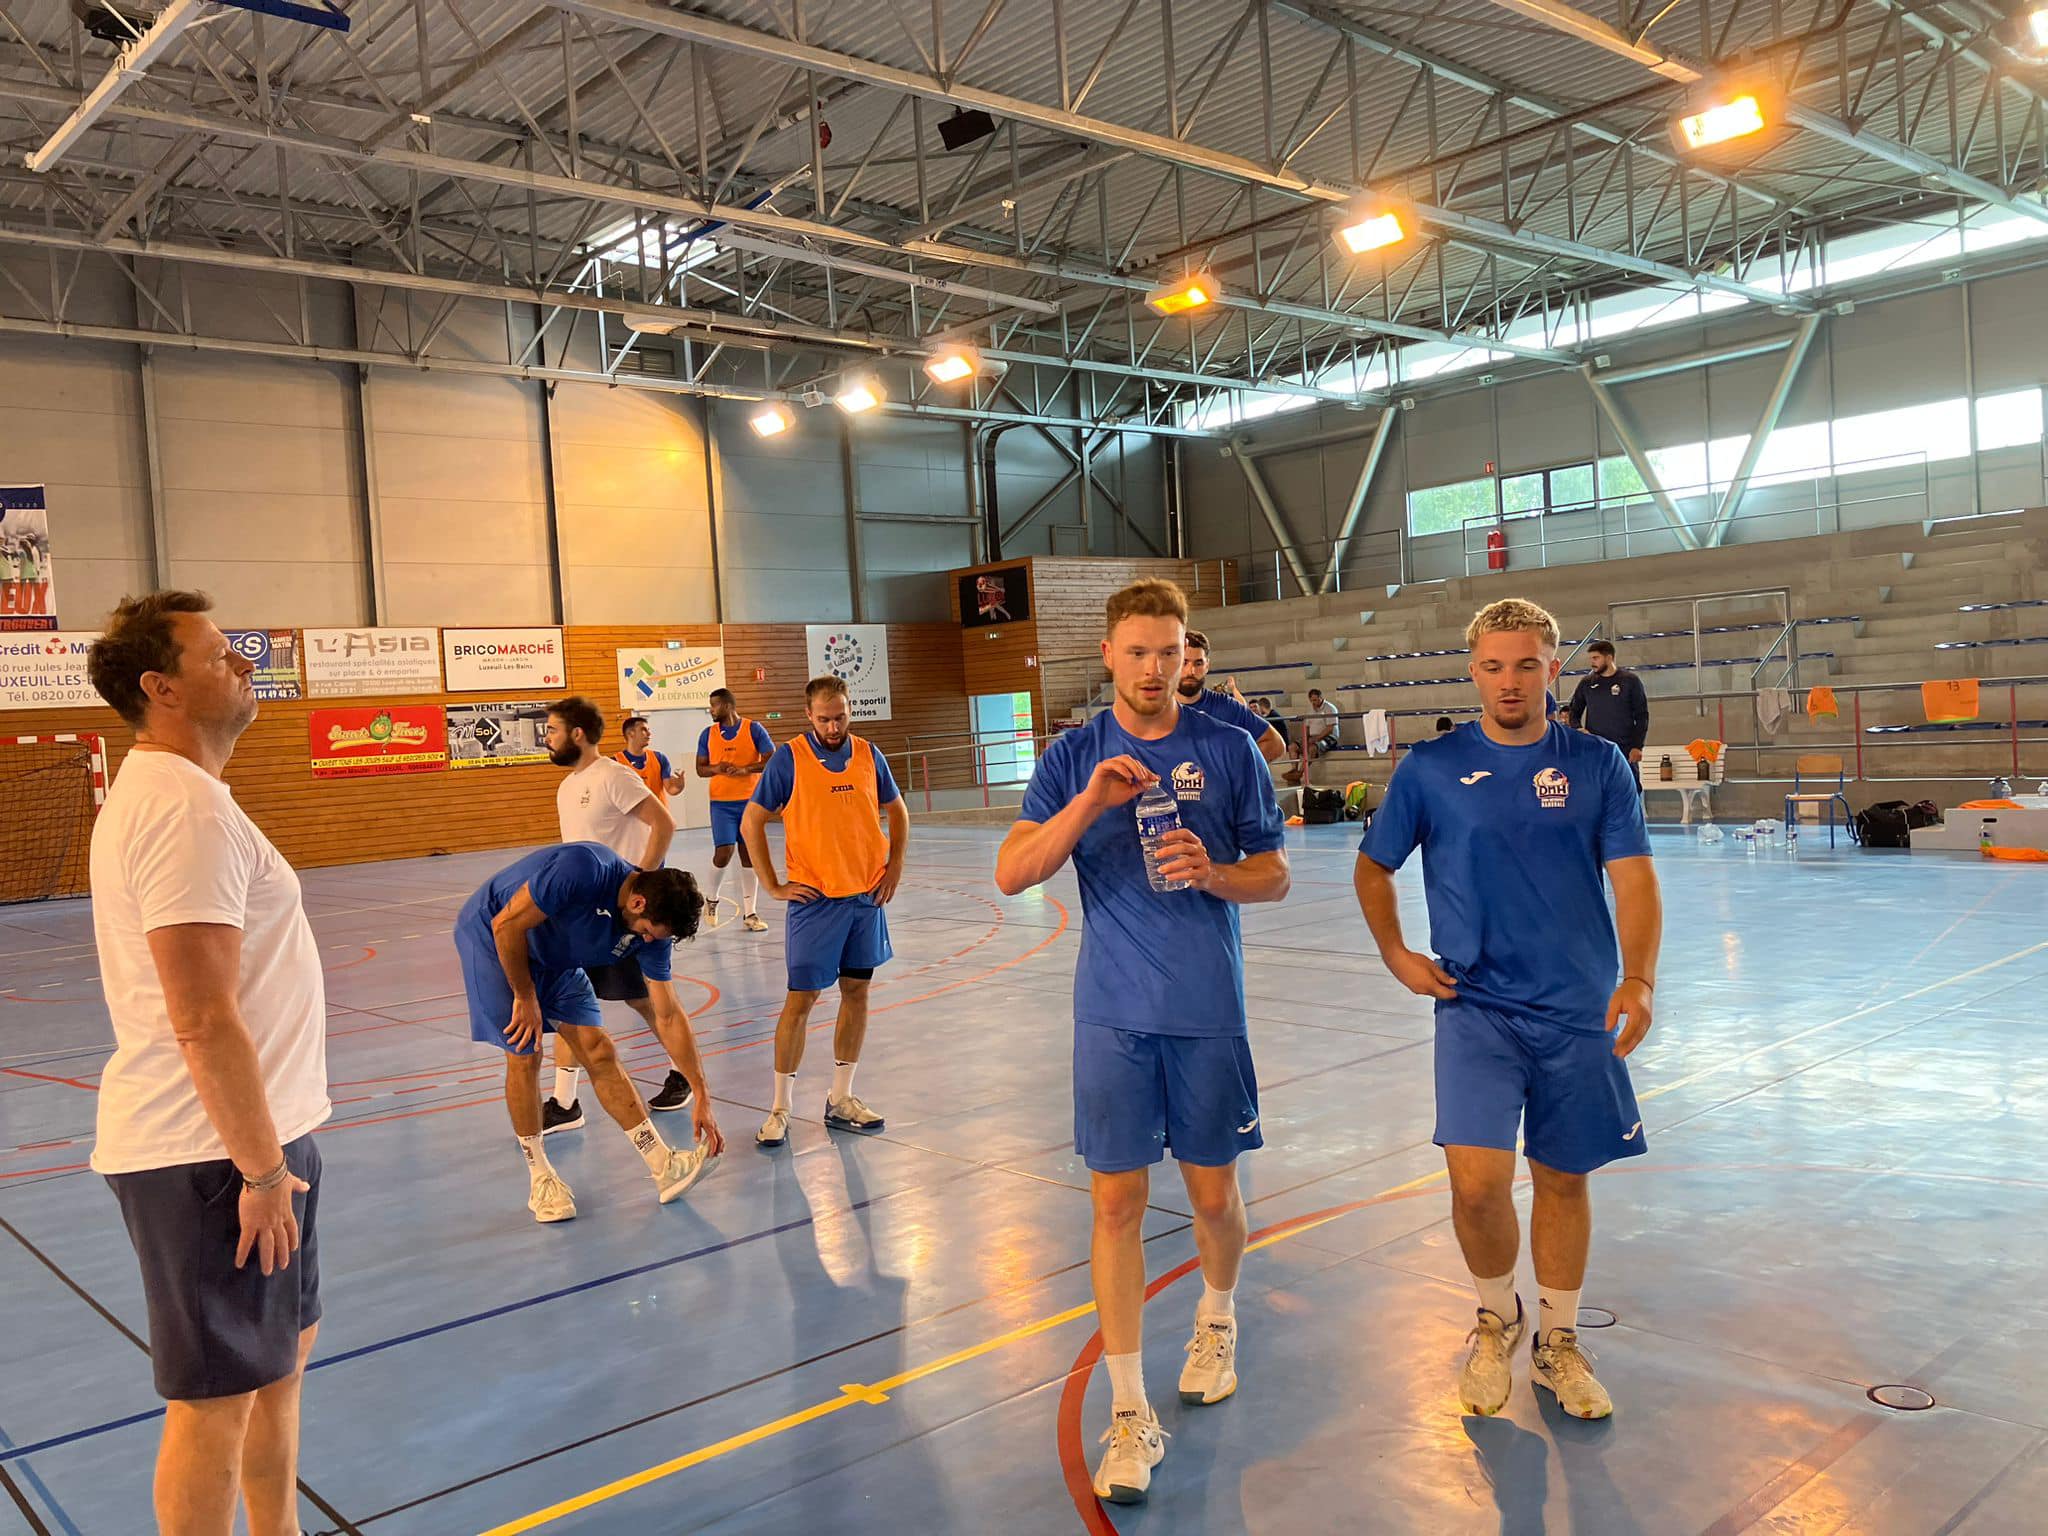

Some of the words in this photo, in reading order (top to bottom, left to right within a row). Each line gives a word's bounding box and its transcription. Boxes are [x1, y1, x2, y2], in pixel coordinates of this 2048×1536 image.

[454, 640, 554, 656] BRICOMARCHÉ
[12, 663, 31, 673] rue
[33, 662, 62, 673] Jules
[665, 656, 703, 673] haute
[675, 667, 715, 687] saône
[1946, 681, 1961, 691] 13
[31, 690, 64, 701] 0820
[66, 689, 91, 700] 076
[859, 696, 887, 706] sportif
[474, 703, 505, 712] VENTE
[475, 727, 494, 736] Sol
[1175, 780, 1203, 789] DMH
[1539, 785, 1567, 796] DMH
